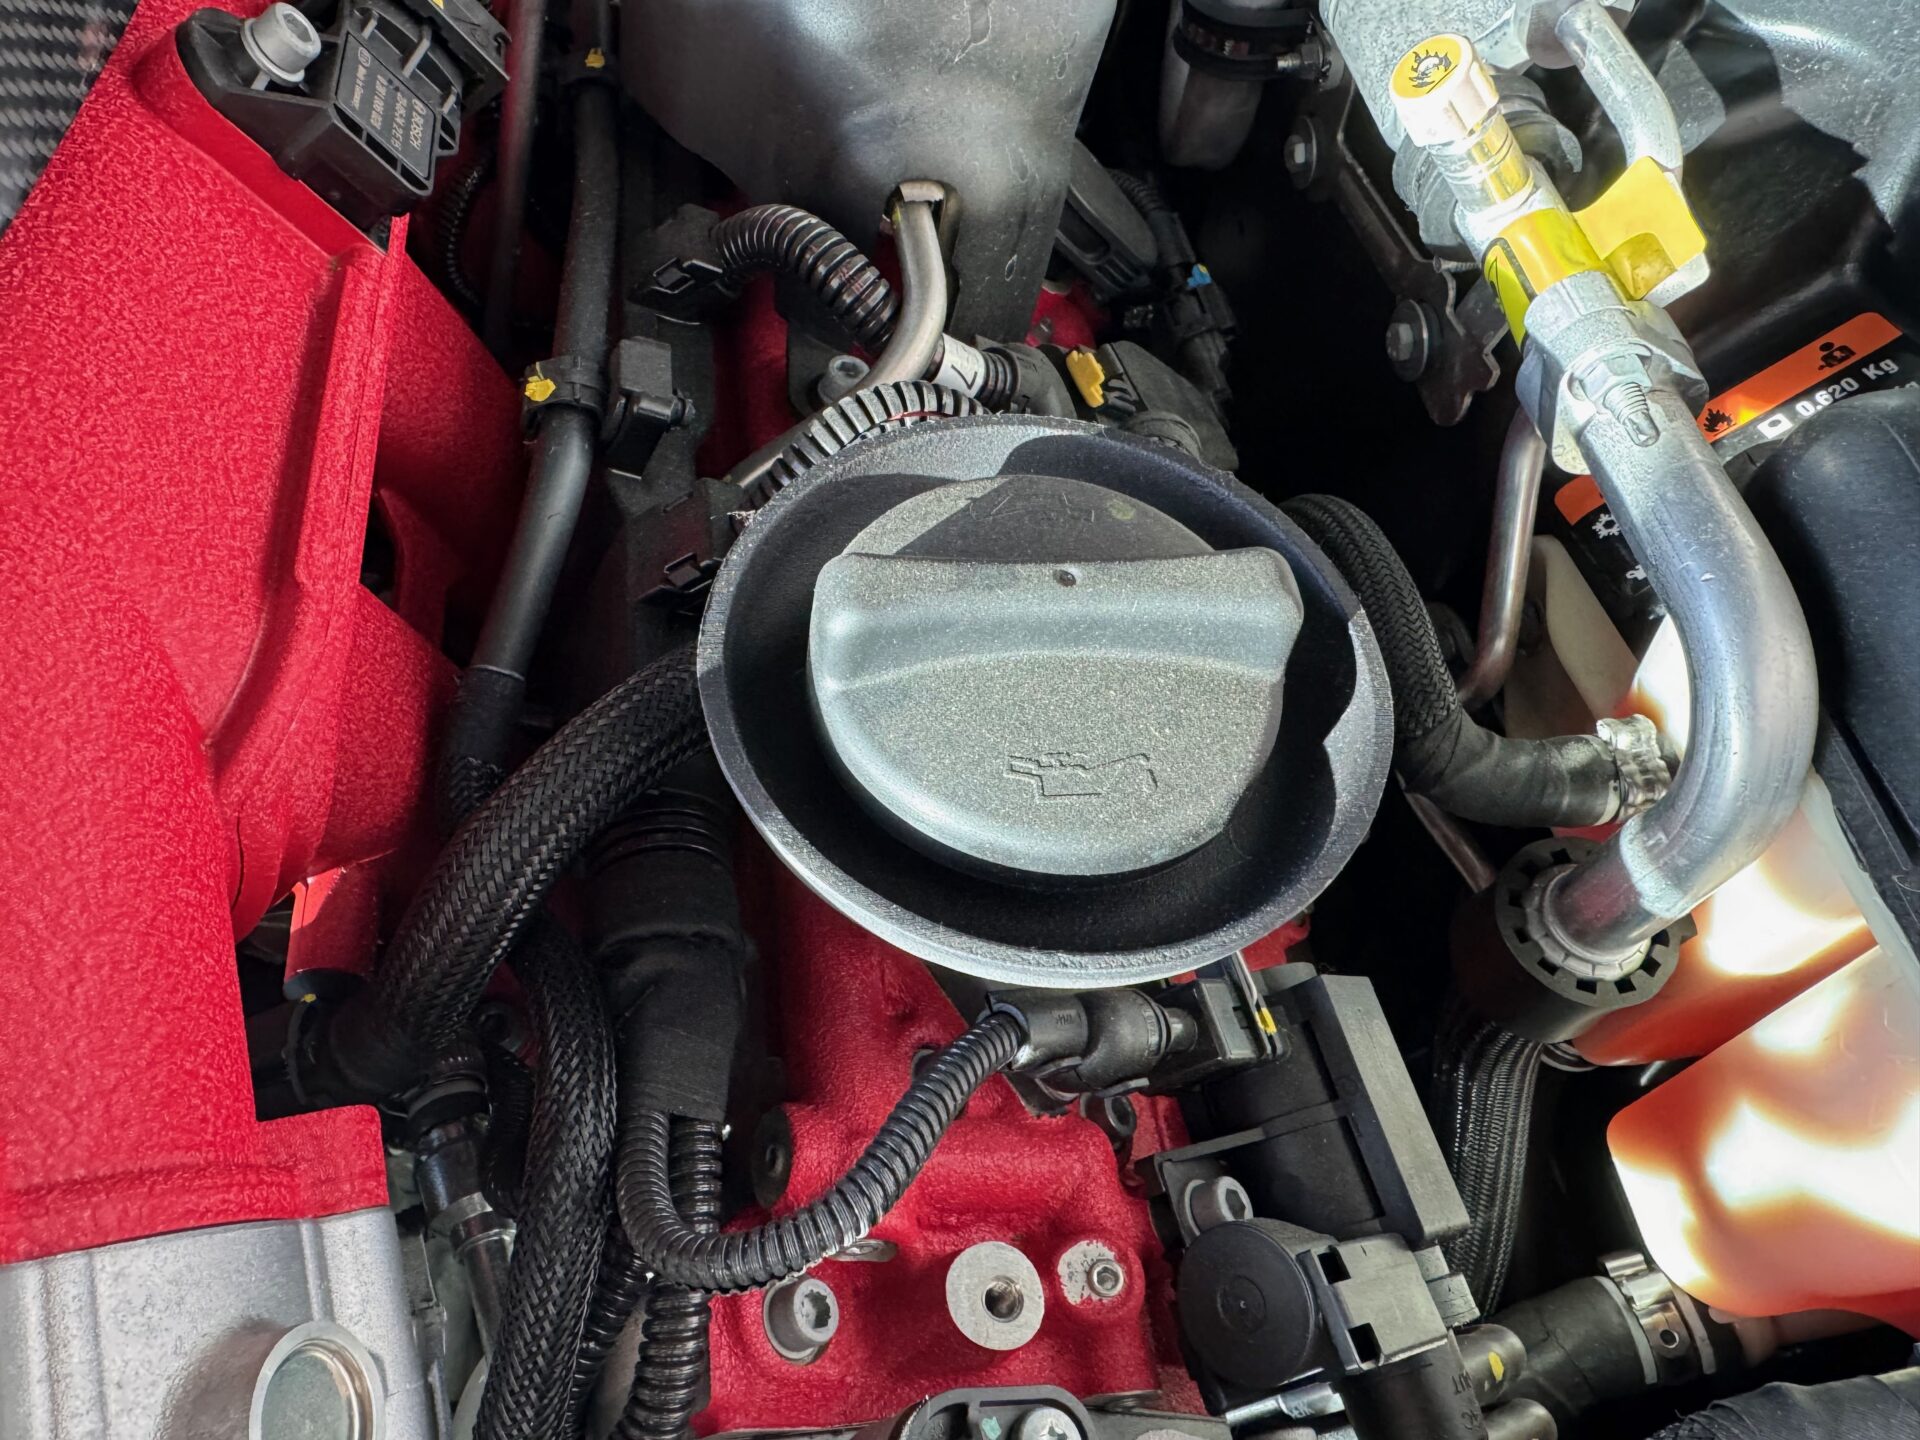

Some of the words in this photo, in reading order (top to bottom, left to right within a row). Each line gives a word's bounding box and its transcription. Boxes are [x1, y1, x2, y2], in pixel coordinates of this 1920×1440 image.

[409, 111, 424, 151] BOSCH
[1795, 377, 1860, 417] 0.620
[1861, 359, 1899, 380] Kg
